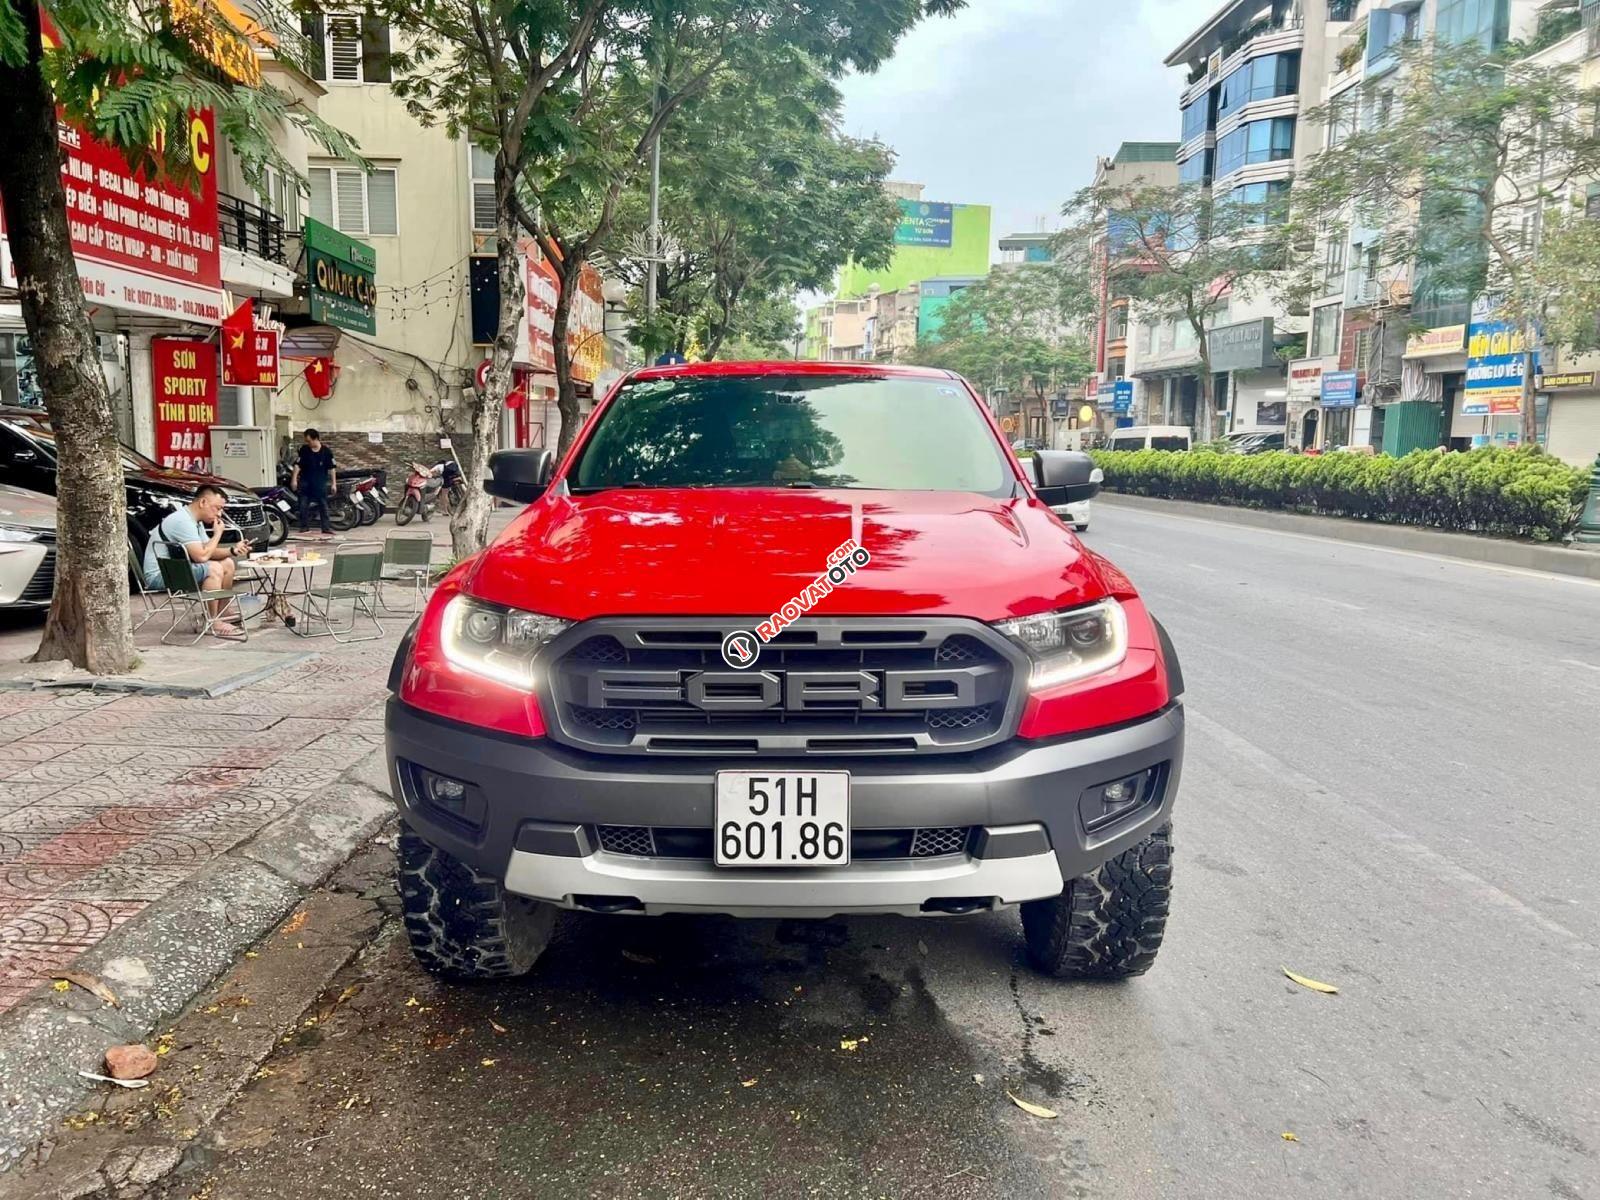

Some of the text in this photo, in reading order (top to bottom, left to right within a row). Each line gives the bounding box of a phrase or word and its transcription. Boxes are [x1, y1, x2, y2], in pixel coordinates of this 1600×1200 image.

[71, 220, 87, 243] CAO
[172, 348, 196, 370] SƠN
[164, 376, 207, 396] SPORTY
[170, 428, 205, 451] DÁN
[586, 667, 976, 712] FORD
[749, 777, 817, 816] 51H
[721, 820, 844, 860] 601.86
